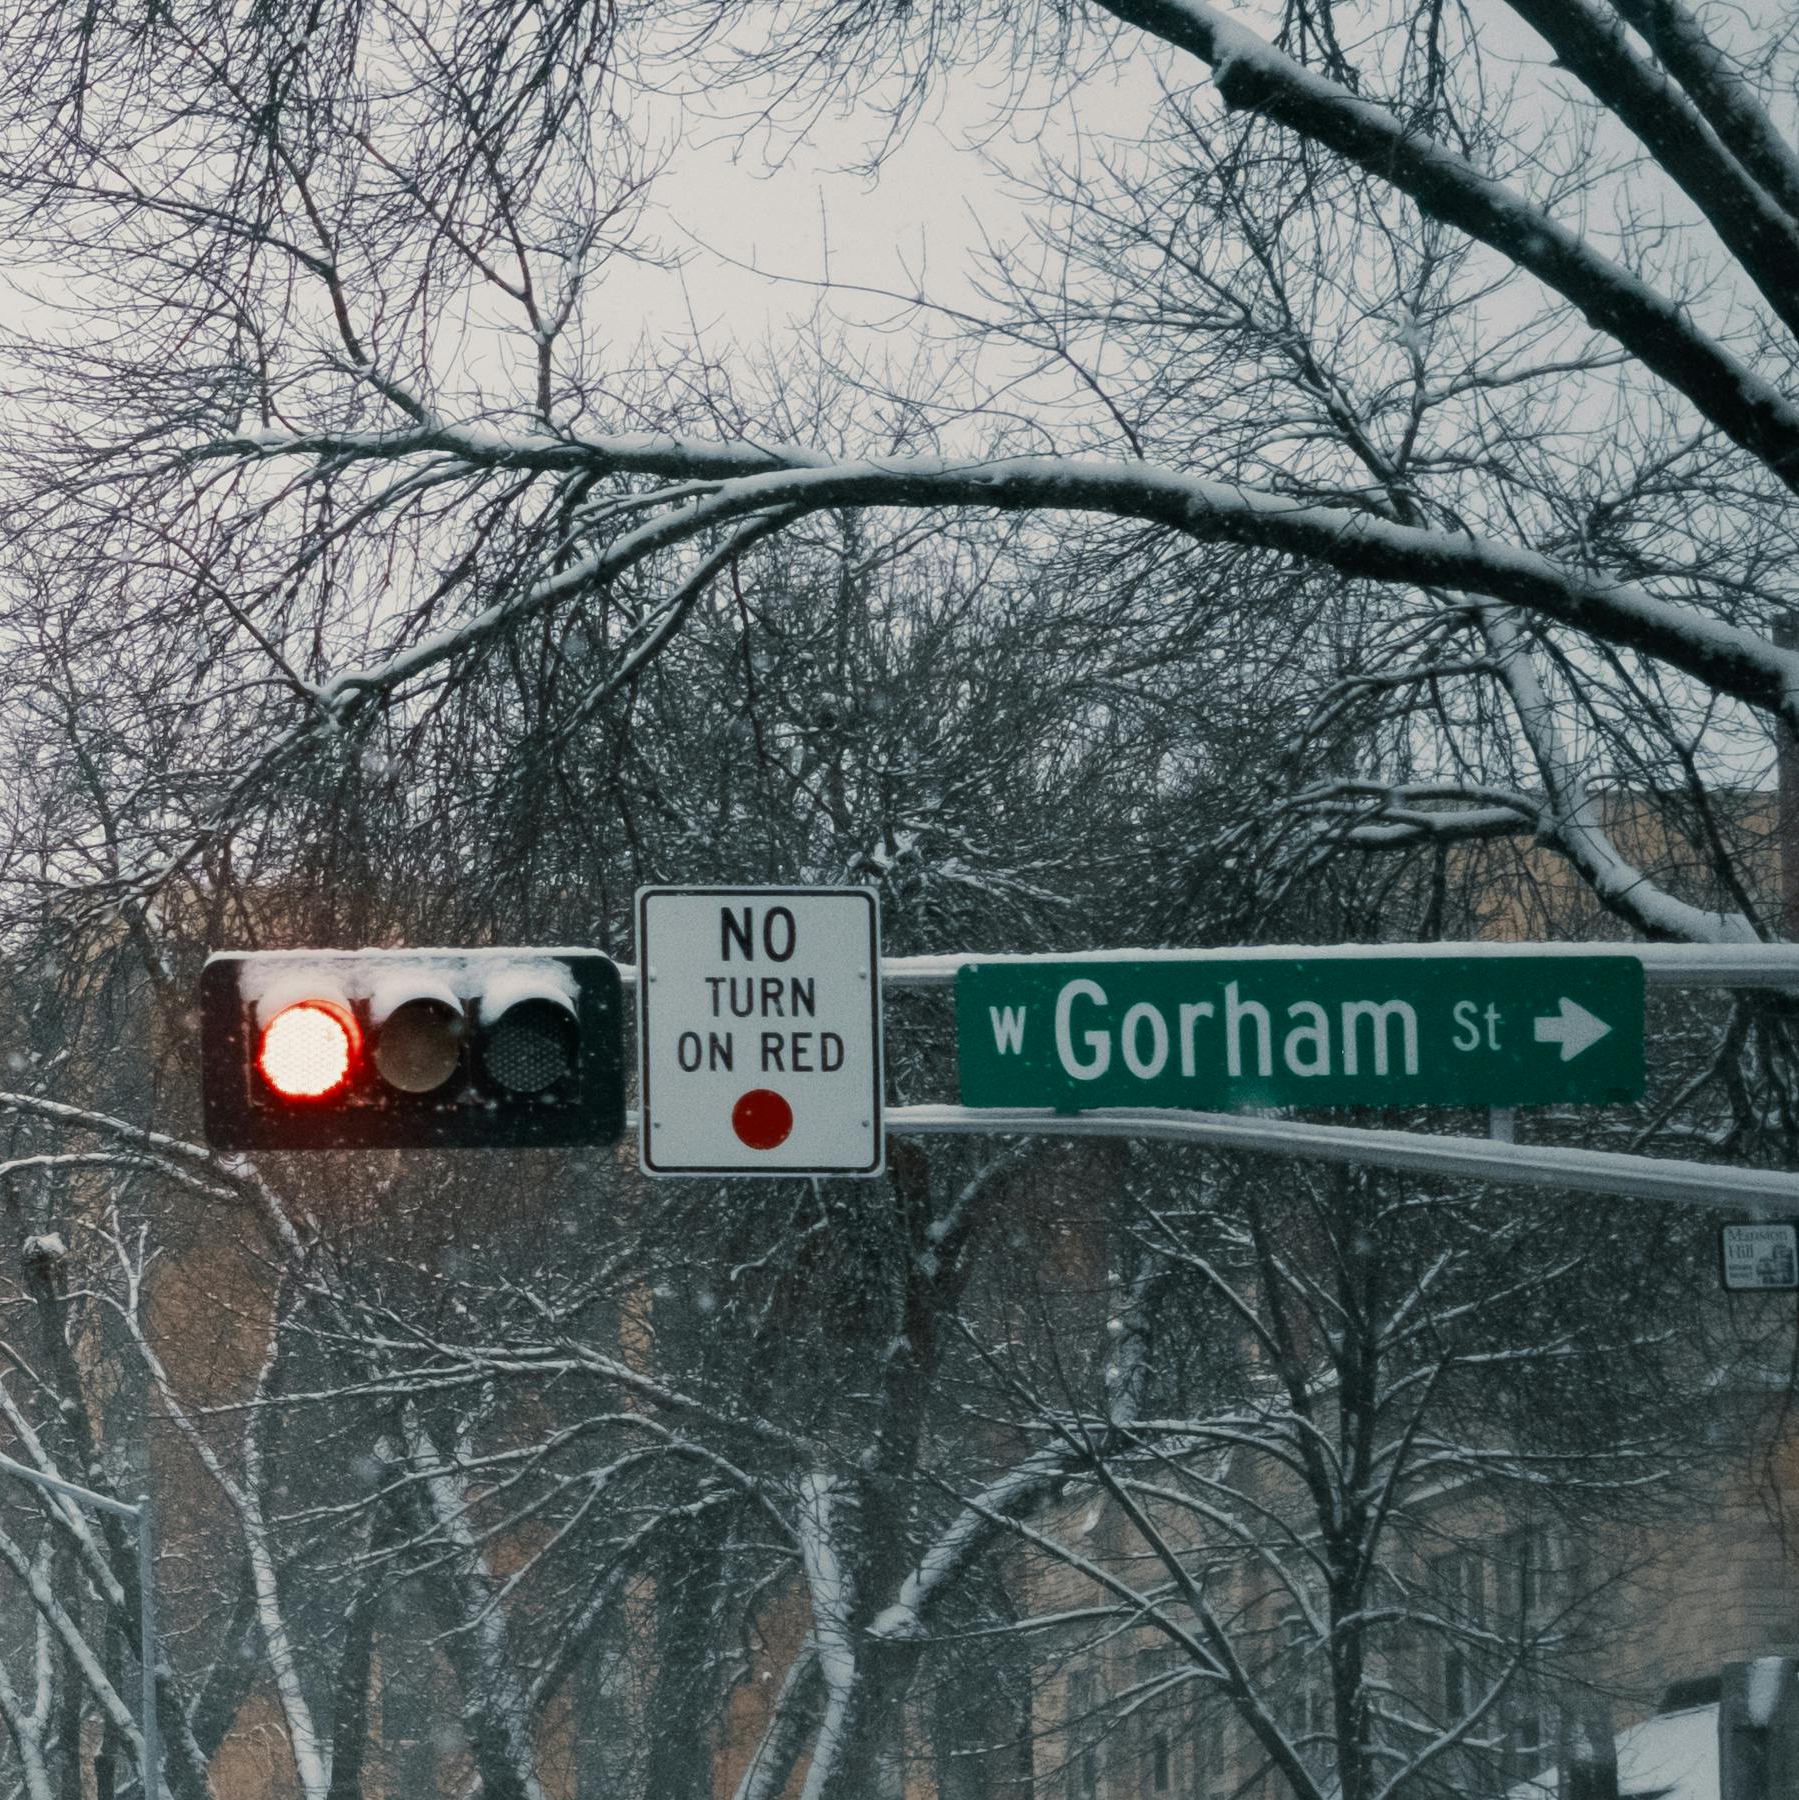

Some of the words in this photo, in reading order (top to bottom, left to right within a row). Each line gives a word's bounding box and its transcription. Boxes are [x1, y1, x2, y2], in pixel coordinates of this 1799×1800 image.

[720, 905, 797, 963] NO
[704, 976, 816, 1018] TURN
[989, 1005, 1027, 1056] W
[1054, 977, 1420, 1081] Gorham
[1451, 1000, 1503, 1051] St
[677, 1030, 734, 1073] ON
[760, 1031, 845, 1073] RED
[1728, 1227, 1789, 1241] Mansion
[1728, 1243, 1754, 1259] Hill
